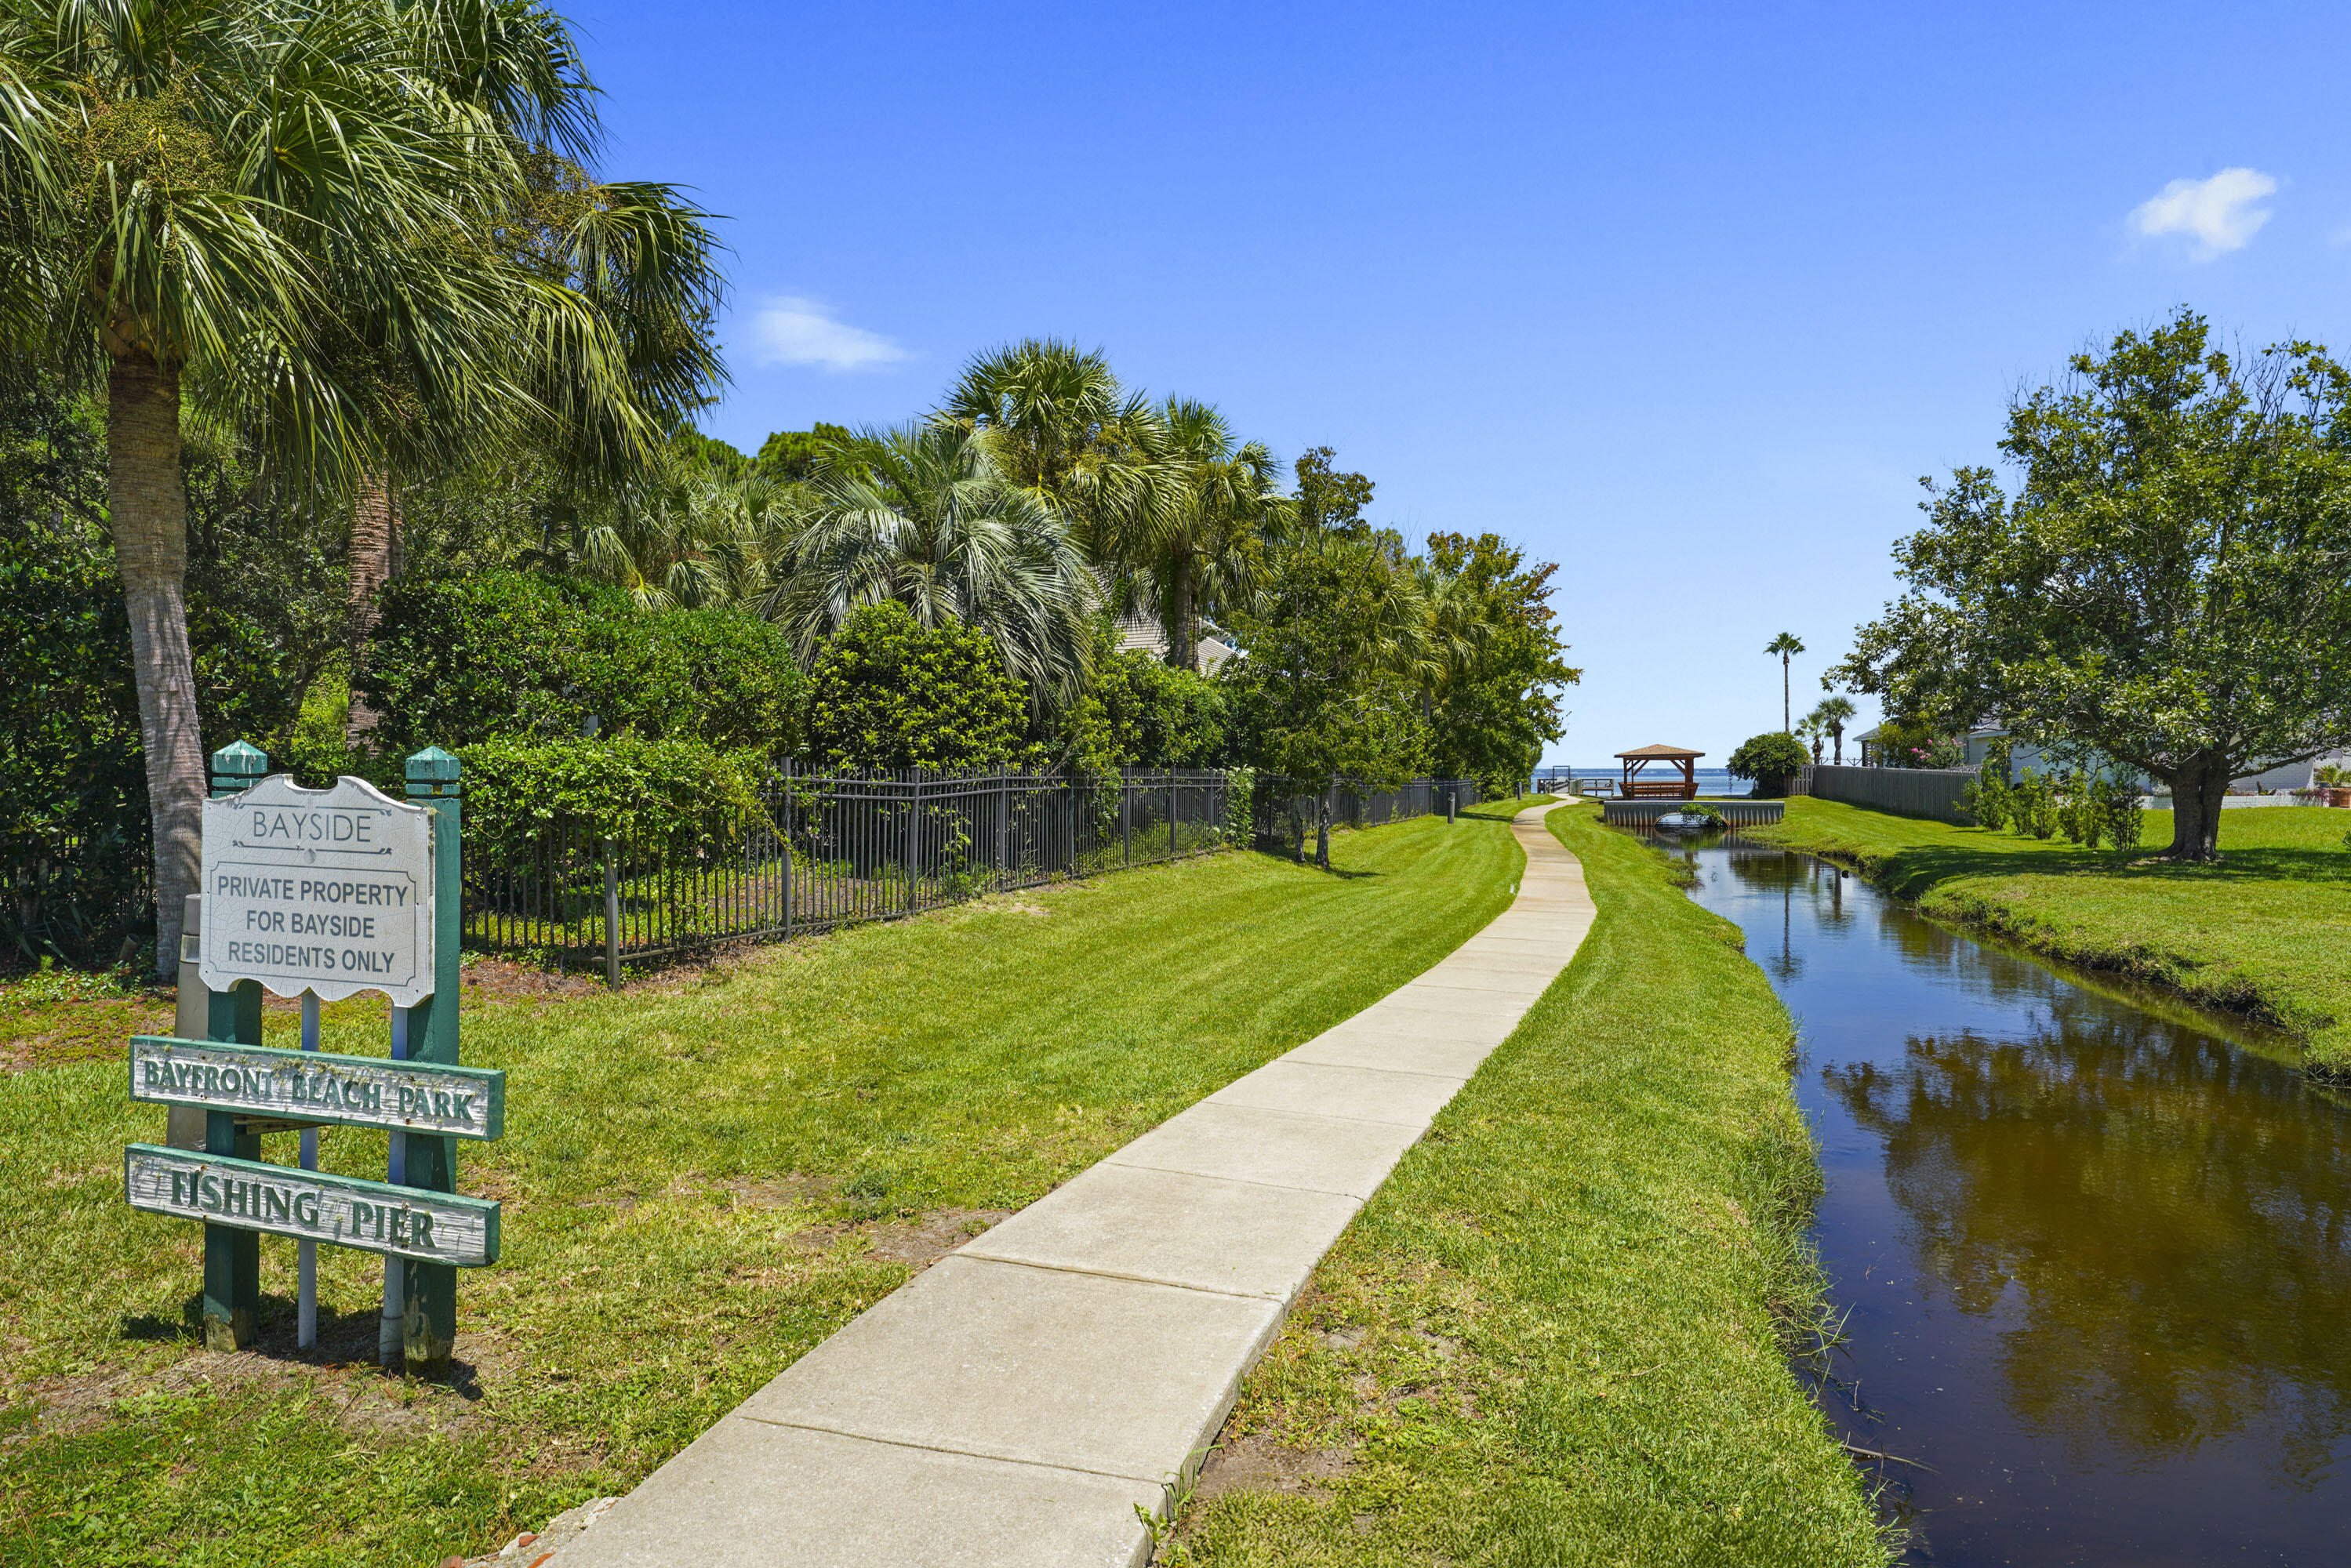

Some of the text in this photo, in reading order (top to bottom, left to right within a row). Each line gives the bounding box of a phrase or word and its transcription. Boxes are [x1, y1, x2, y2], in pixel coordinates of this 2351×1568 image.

[253, 811, 371, 842] BAYSIDE
[218, 876, 409, 906] PRIVATE PROPERTY
[247, 910, 375, 938] FOR BAYSIDE
[228, 942, 394, 973] RESIDENTS ONLY
[144, 1061, 474, 1120] BAYFRONT BEACH PARK
[171, 1169, 436, 1248] FISHING PIER
